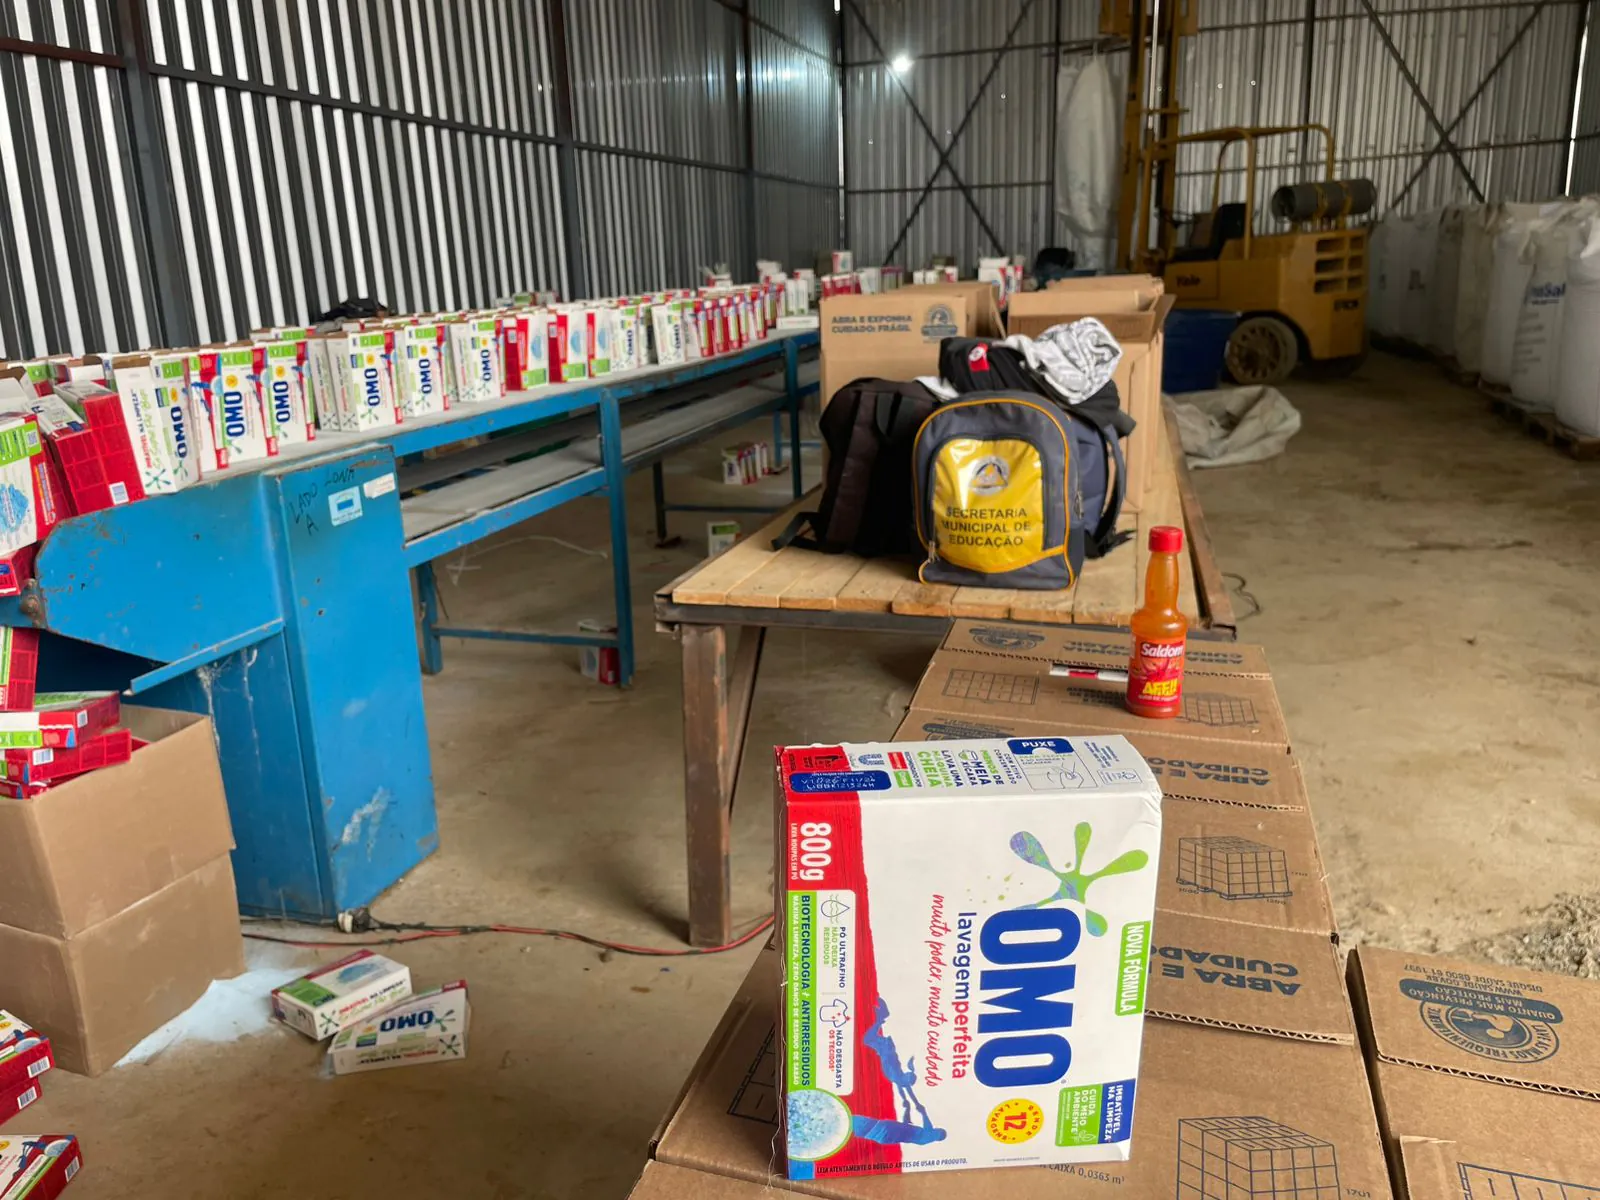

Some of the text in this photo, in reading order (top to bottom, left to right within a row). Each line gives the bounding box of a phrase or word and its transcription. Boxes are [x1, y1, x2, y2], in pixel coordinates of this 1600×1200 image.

[418, 358, 433, 395] OMO
[480, 349, 493, 382] OMO
[272, 380, 291, 423] OMO
[364, 367, 381, 407] OMO
[224, 390, 246, 438] OMO
[170, 406, 188, 459] OMO
[946, 506, 1027, 518] SECRETARIA
[1014, 520, 1031, 532] DE
[948, 535, 1024, 547] EDUCAÇÃO
[917, 751, 943, 787] CHEIA
[941, 750, 964, 787] LAVA UMA
[974, 761, 991, 785] MEIA
[1192, 771, 1271, 787] ABRA
[790, 823, 798, 837] LAVA
[790, 838, 798, 861] ROUPAS
[799, 822, 832, 881] 800g
[929, 894, 951, 937] muito
[801, 895, 811, 989] BIOTECNOLOGIA
[839, 926, 846, 938] PÓ
[1119, 925, 1145, 1013] NOVA FÓRMULA
[1162, 963, 1301, 997] ABRA E
[973, 907, 1081, 1088] OMO
[1494, 995, 1523, 1006] MAIS
[1507, 980, 1543, 993] DISQUE
[380, 1010, 434, 1032] OMO
[926, 987, 948, 1027] muito
[1476, 1001, 1504, 1013] MAIS
[1508, 1006, 1556, 1020] QUANTO
[801, 1000, 811, 1086] ANTIRRESÍDUOS
[829, 1030, 835, 1040] OS
[924, 1031, 944, 1087] cuidado
[1079, 1090, 1089, 1126] DO MEIO
[1088, 1089, 1097, 1116] CUIDA
[1107, 1086, 1115, 1100] NA
[1003, 1112, 1027, 1131] 12
[1112, 1085, 1123, 1133] IMBATÍVEL
[817, 1166, 829, 1174] LEIA
[829, 1164, 867, 1173] ATENTAMENTE
[895, 1161, 912, 1169] ANTES
[1078, 1168, 1110, 1182] 0,0363
